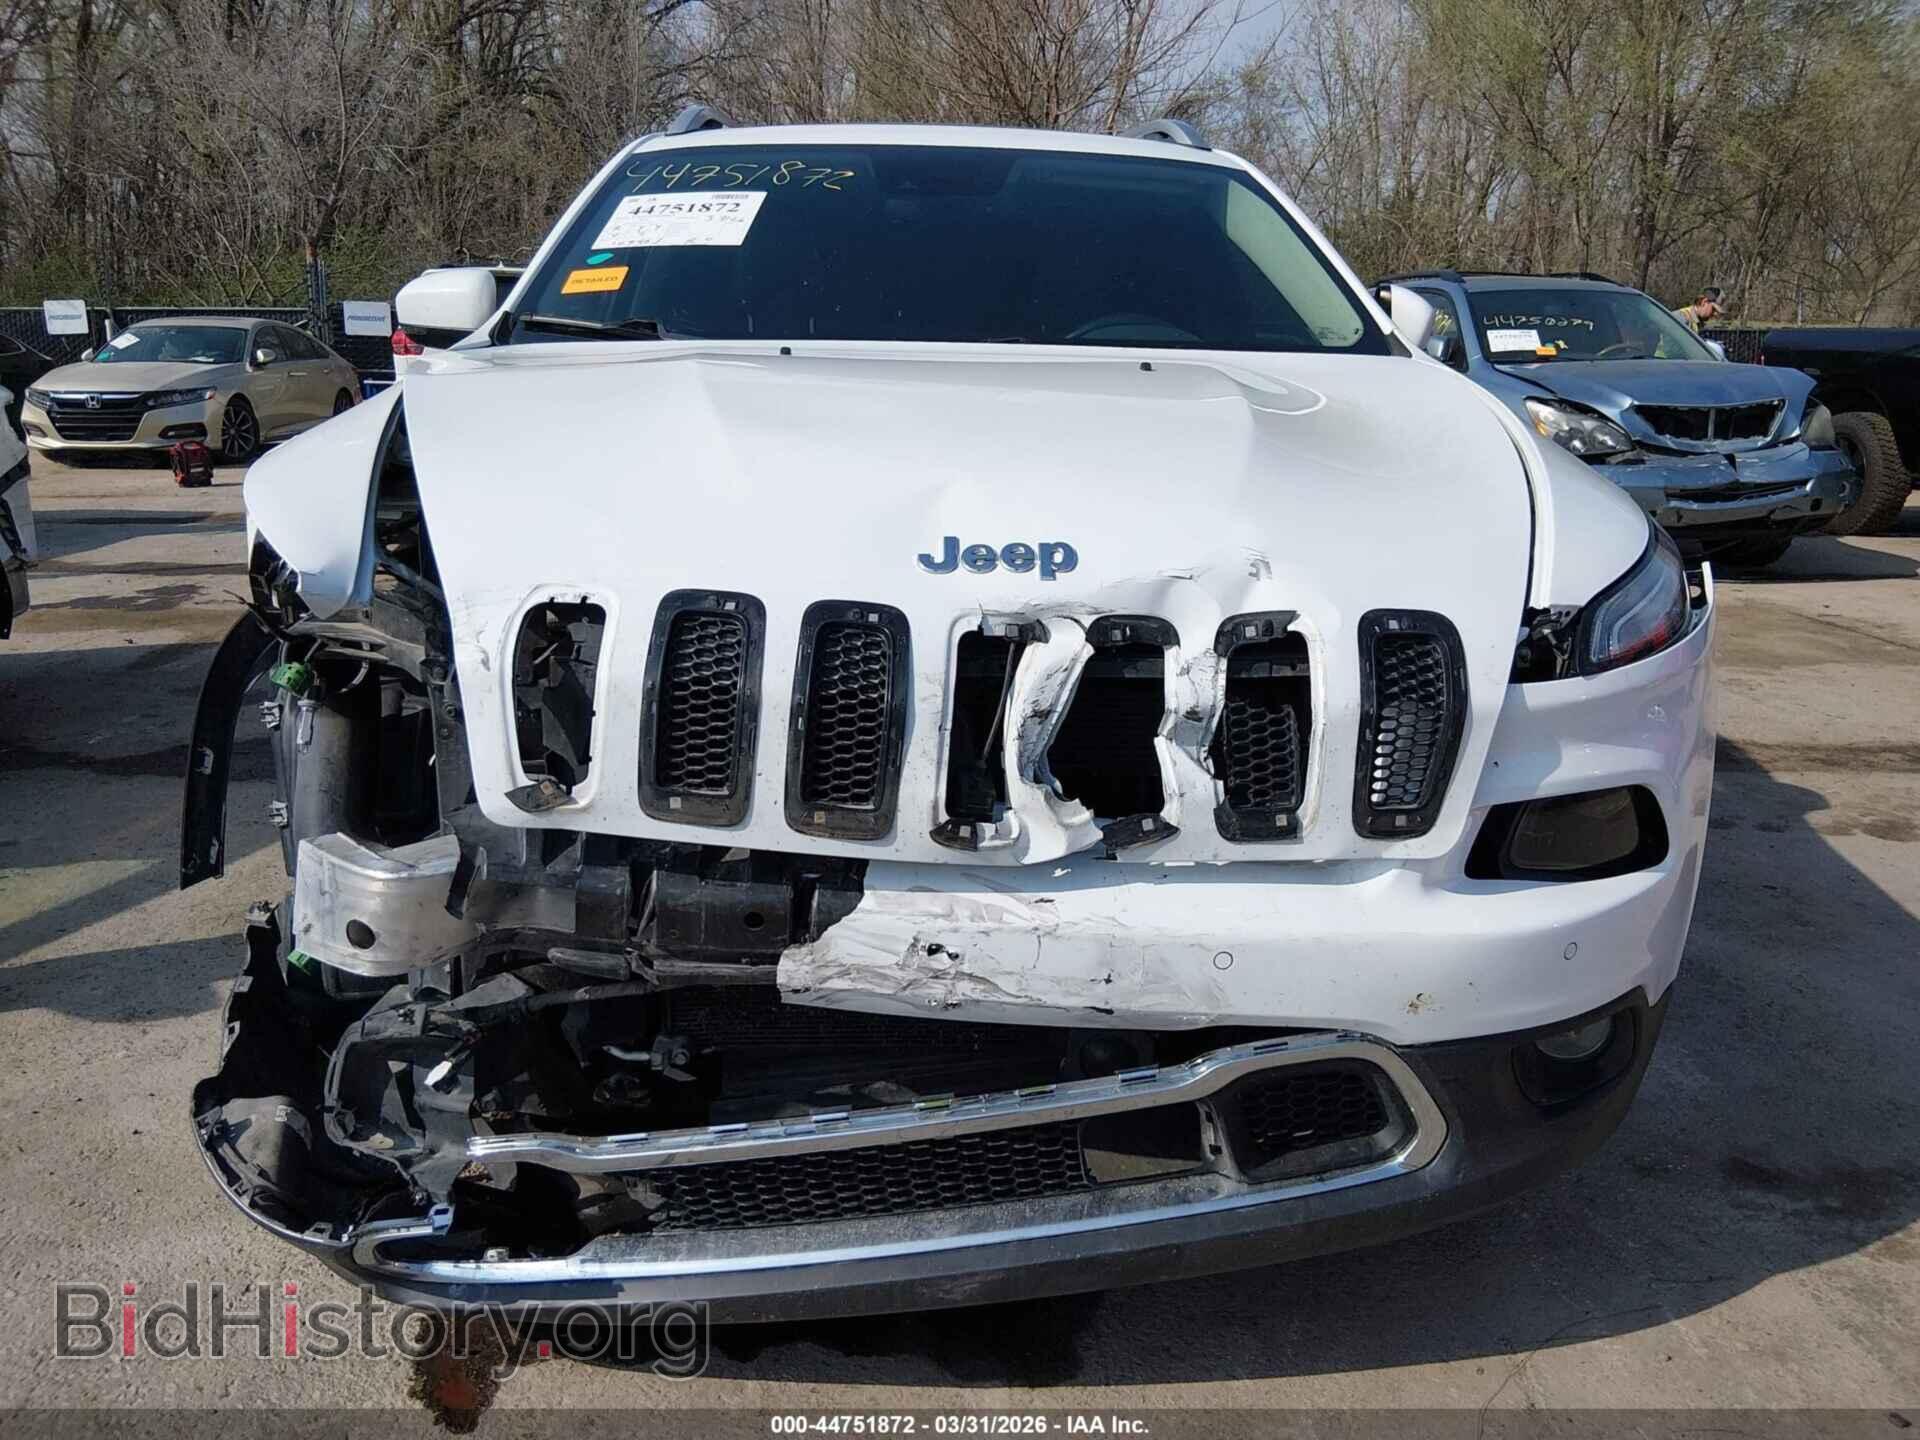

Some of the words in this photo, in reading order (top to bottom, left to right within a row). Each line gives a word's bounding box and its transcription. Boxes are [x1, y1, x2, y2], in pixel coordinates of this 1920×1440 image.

[626, 160, 855, 192] 44751872
[628, 202, 741, 216] 44751872
[917, 535, 1079, 581] Jeep
